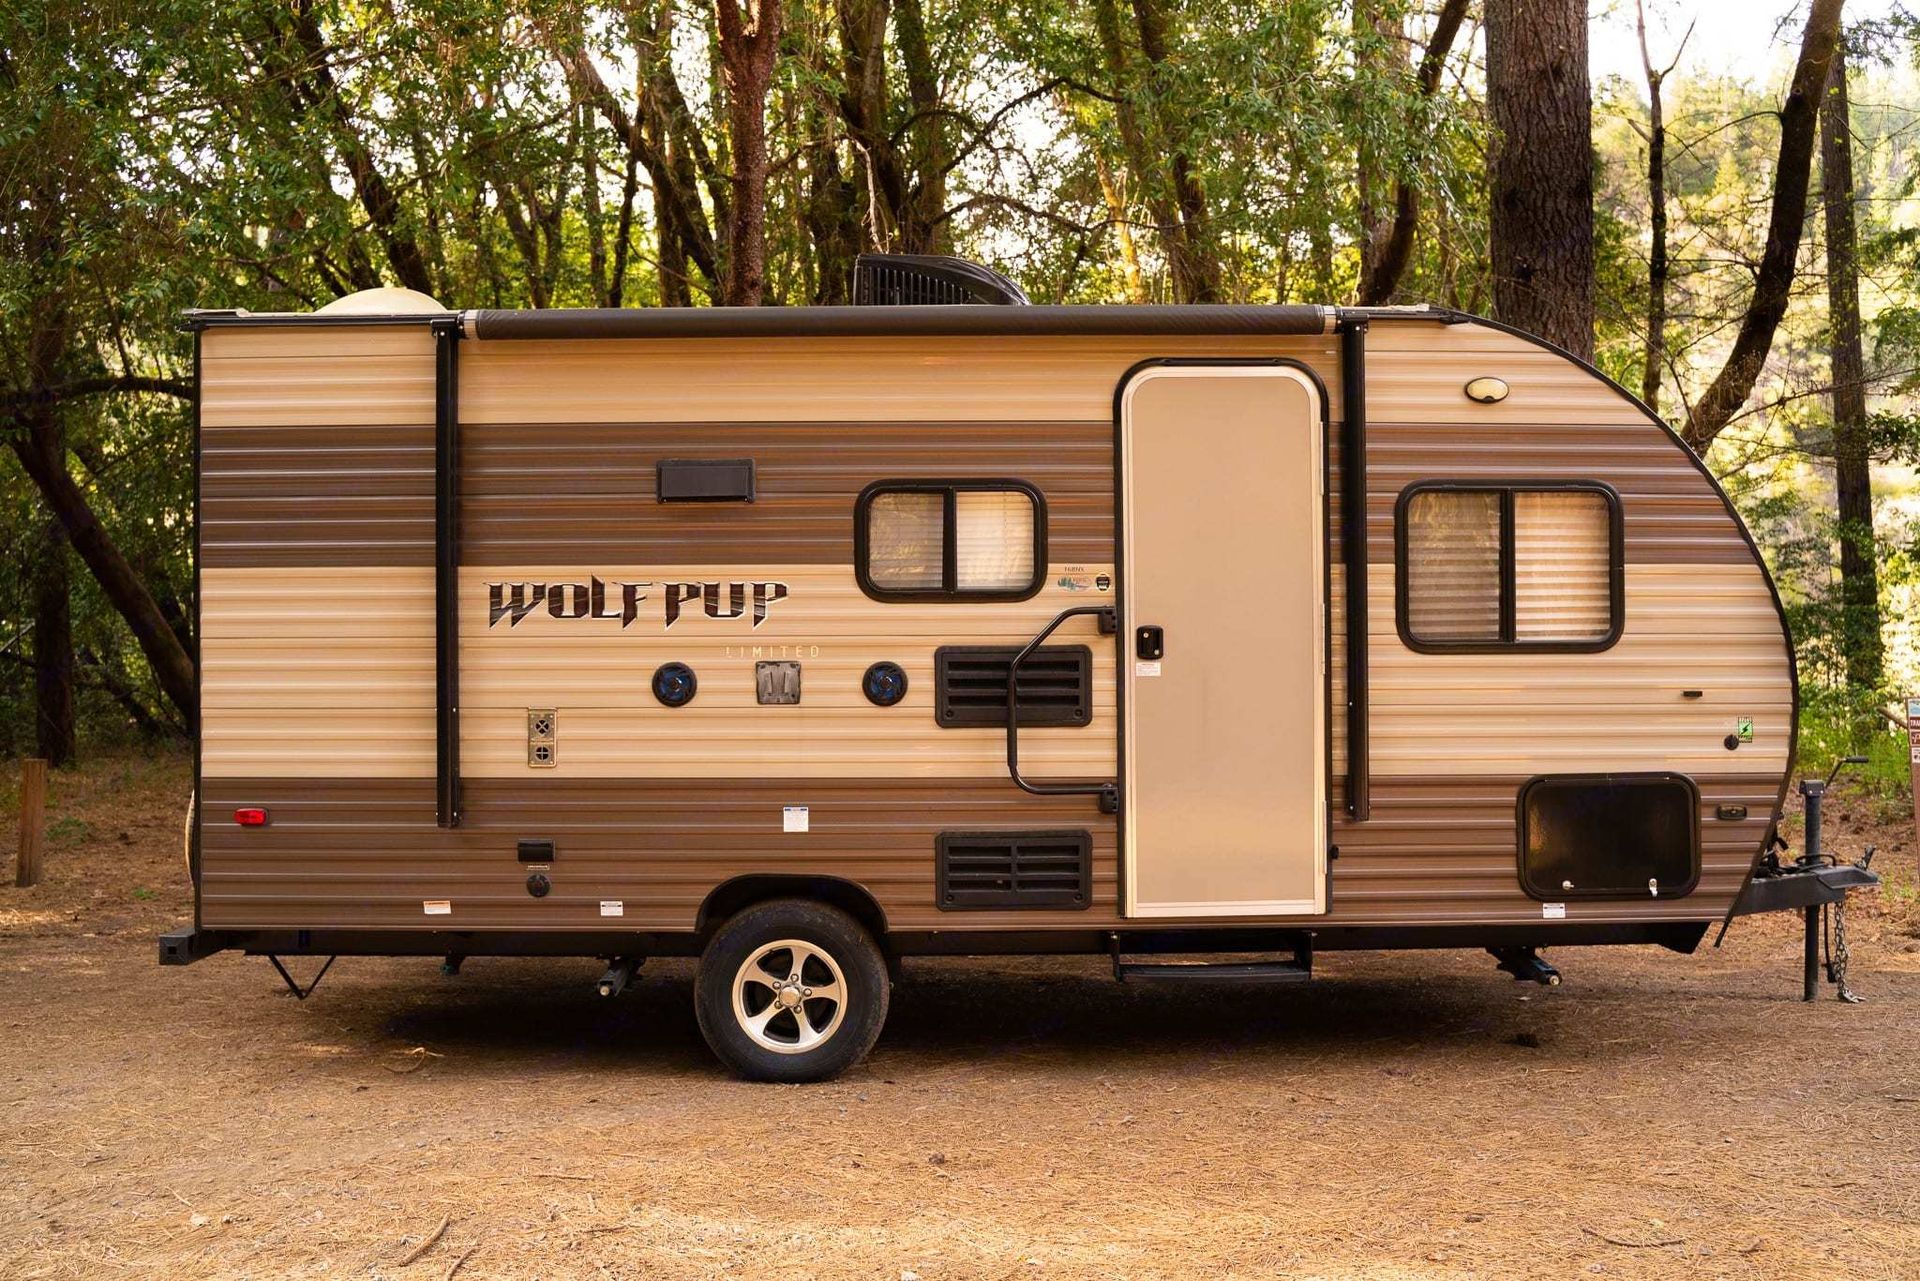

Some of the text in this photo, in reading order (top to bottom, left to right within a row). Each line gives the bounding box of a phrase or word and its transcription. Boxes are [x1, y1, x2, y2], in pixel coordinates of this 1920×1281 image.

[483, 574, 788, 630] WOLF PUP
[725, 645, 819, 659] LIMITED
